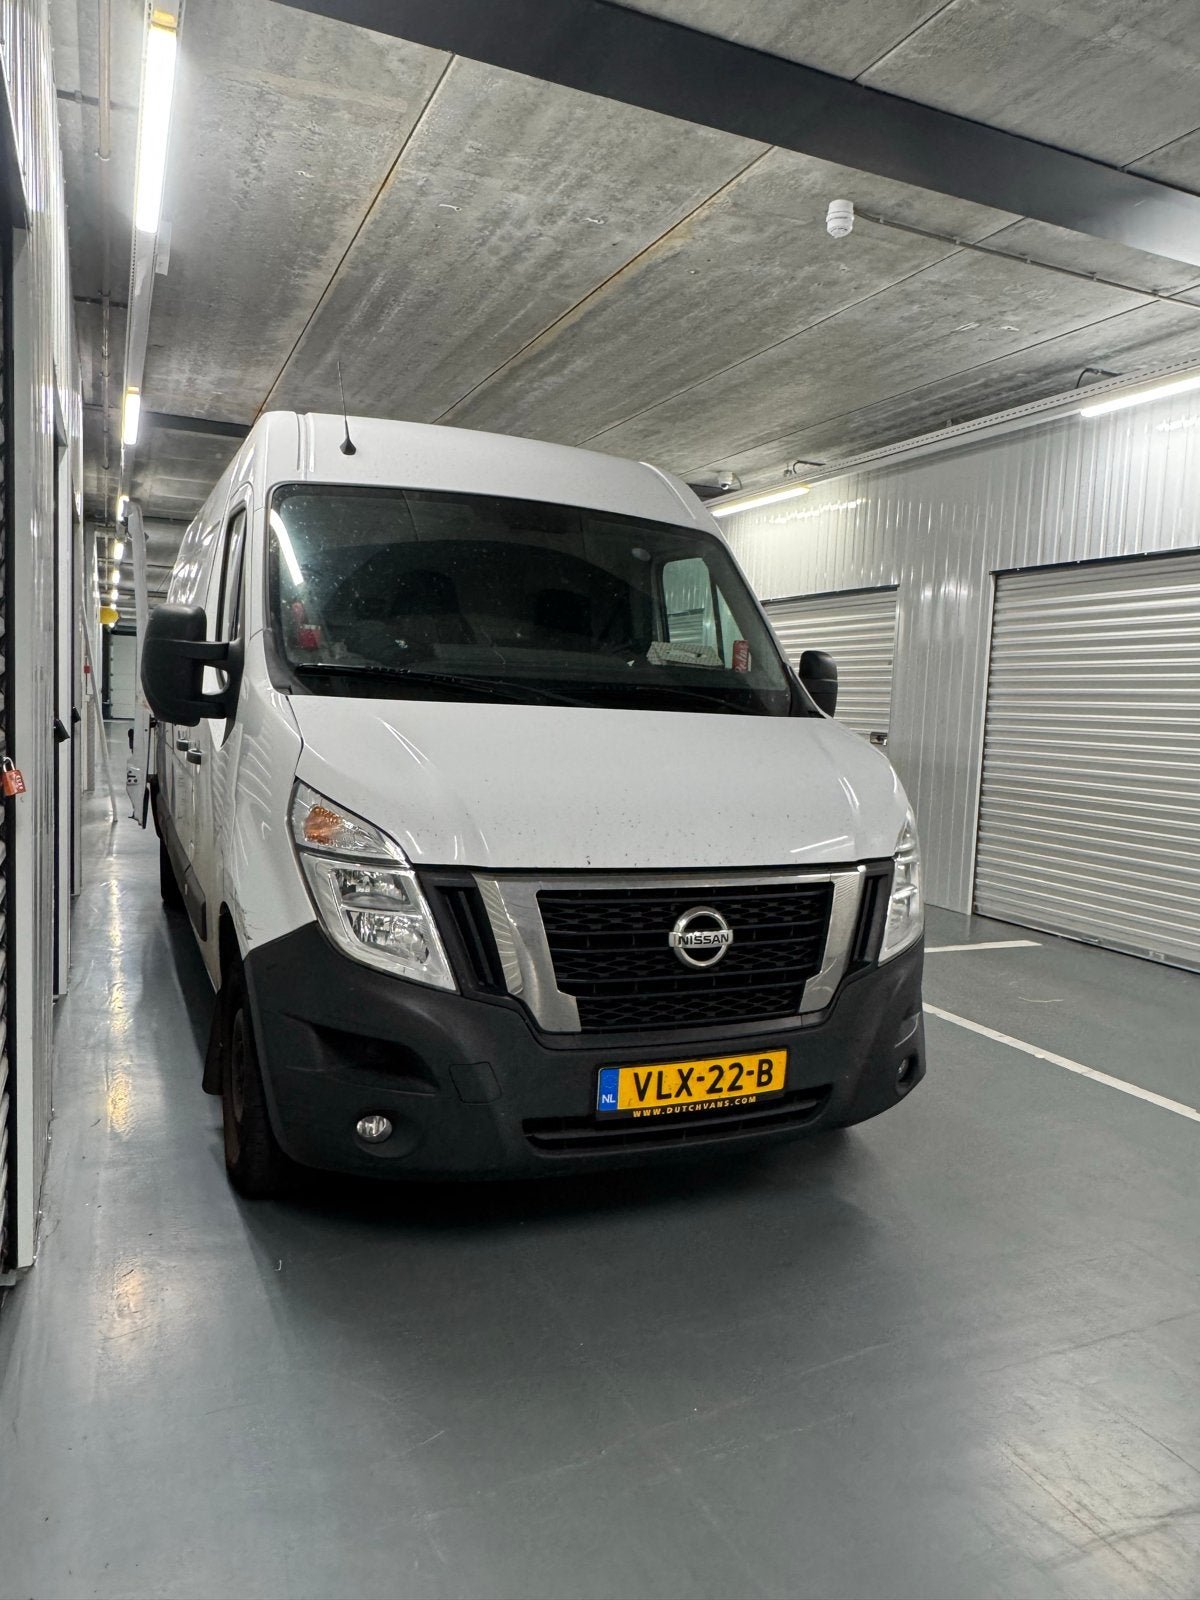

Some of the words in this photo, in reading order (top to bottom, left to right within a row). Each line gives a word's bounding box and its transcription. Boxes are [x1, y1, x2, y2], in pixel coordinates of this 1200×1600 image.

[678, 934, 729, 945] NISSAN
[602, 1094, 616, 1103] NL
[633, 1058, 774, 1102] VLX-22-B
[633, 1096, 757, 1118] WWW.DUTCHVANS.COM
